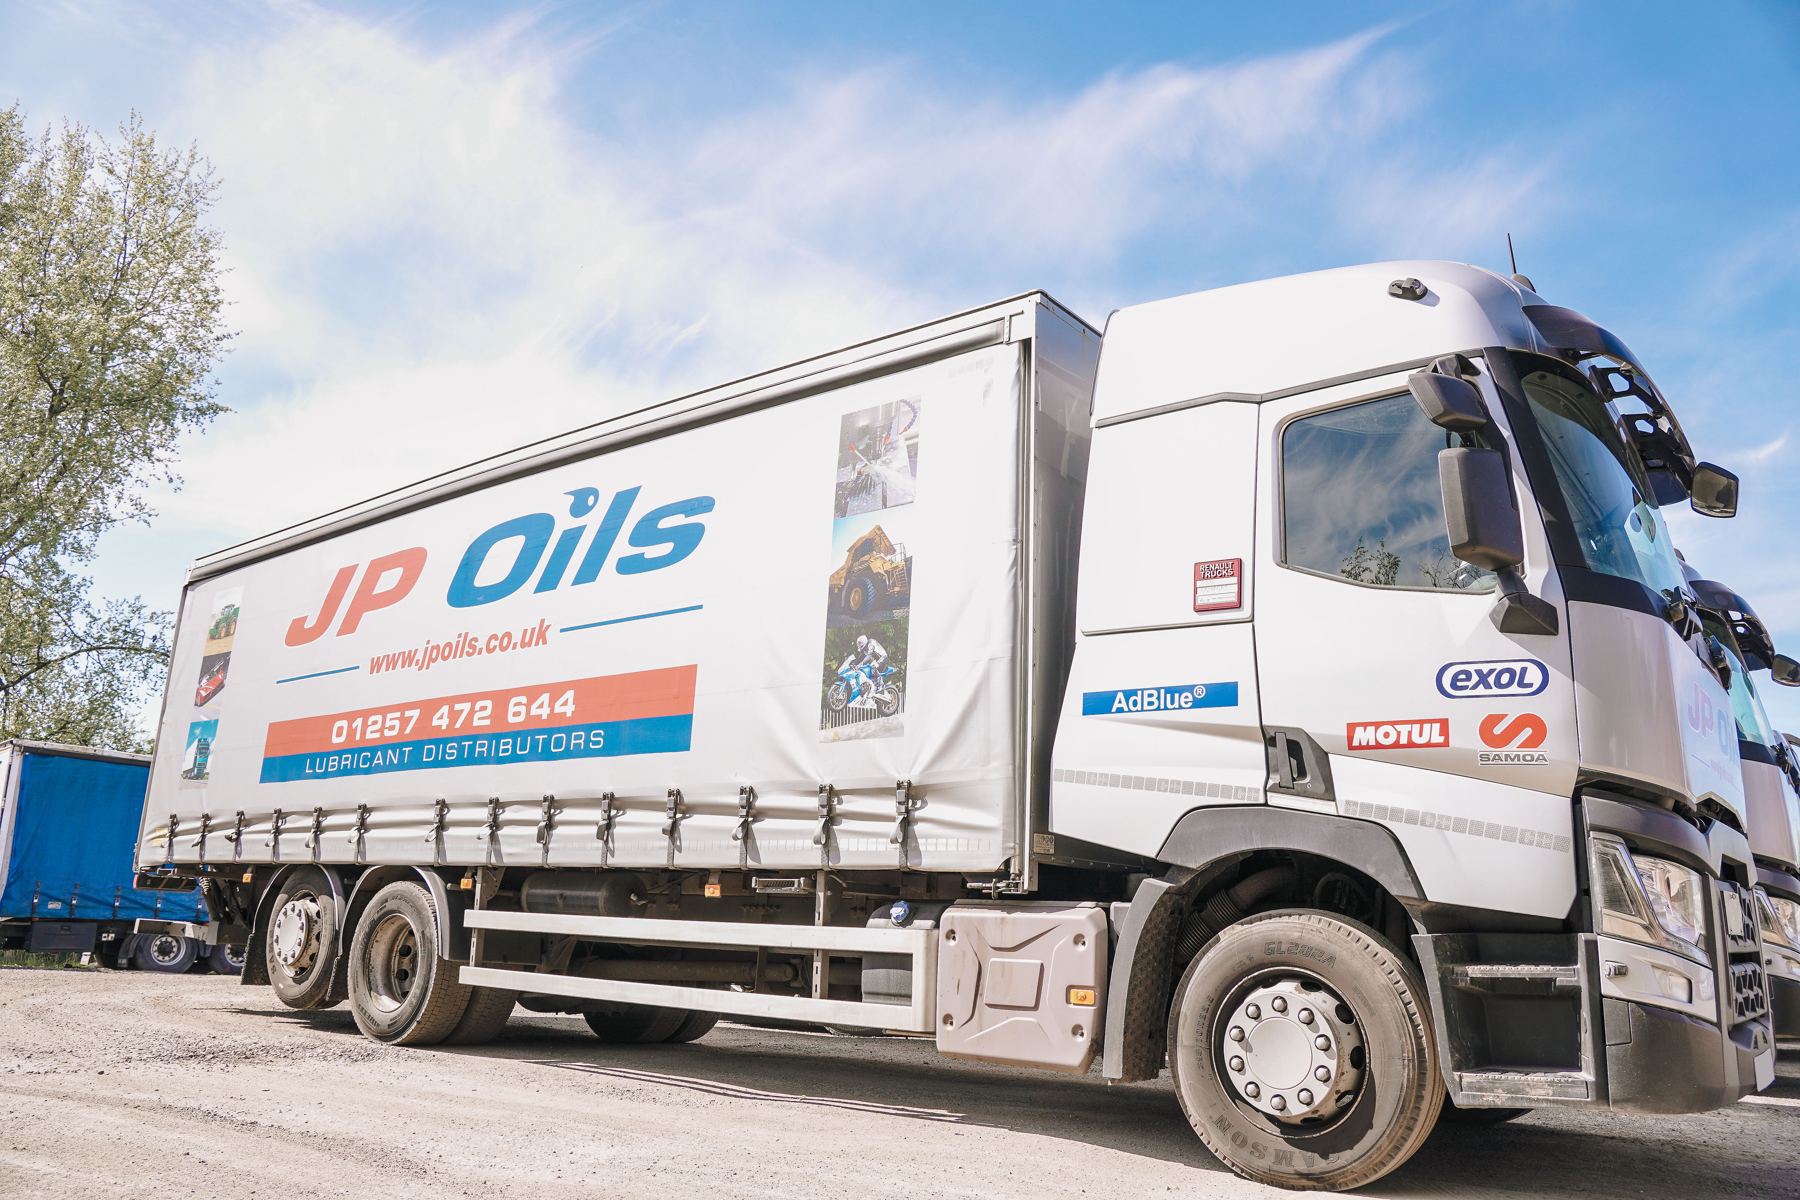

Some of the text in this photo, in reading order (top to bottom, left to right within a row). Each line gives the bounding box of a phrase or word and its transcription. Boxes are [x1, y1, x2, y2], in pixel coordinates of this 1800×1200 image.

[284, 485, 716, 647] JP Oils
[1200, 561, 1234, 573] RENAULT
[1200, 568, 1234, 578] TRUCKS
[369, 618, 552, 676] www.jpoils.co.uk
[331, 690, 576, 744] 01257 472 644
[305, 730, 605, 773] LUBRICANT DISTRIBUTORS
[1352, 722, 1445, 747] MOTUL
[1479, 753, 1549, 763] SAMOA
